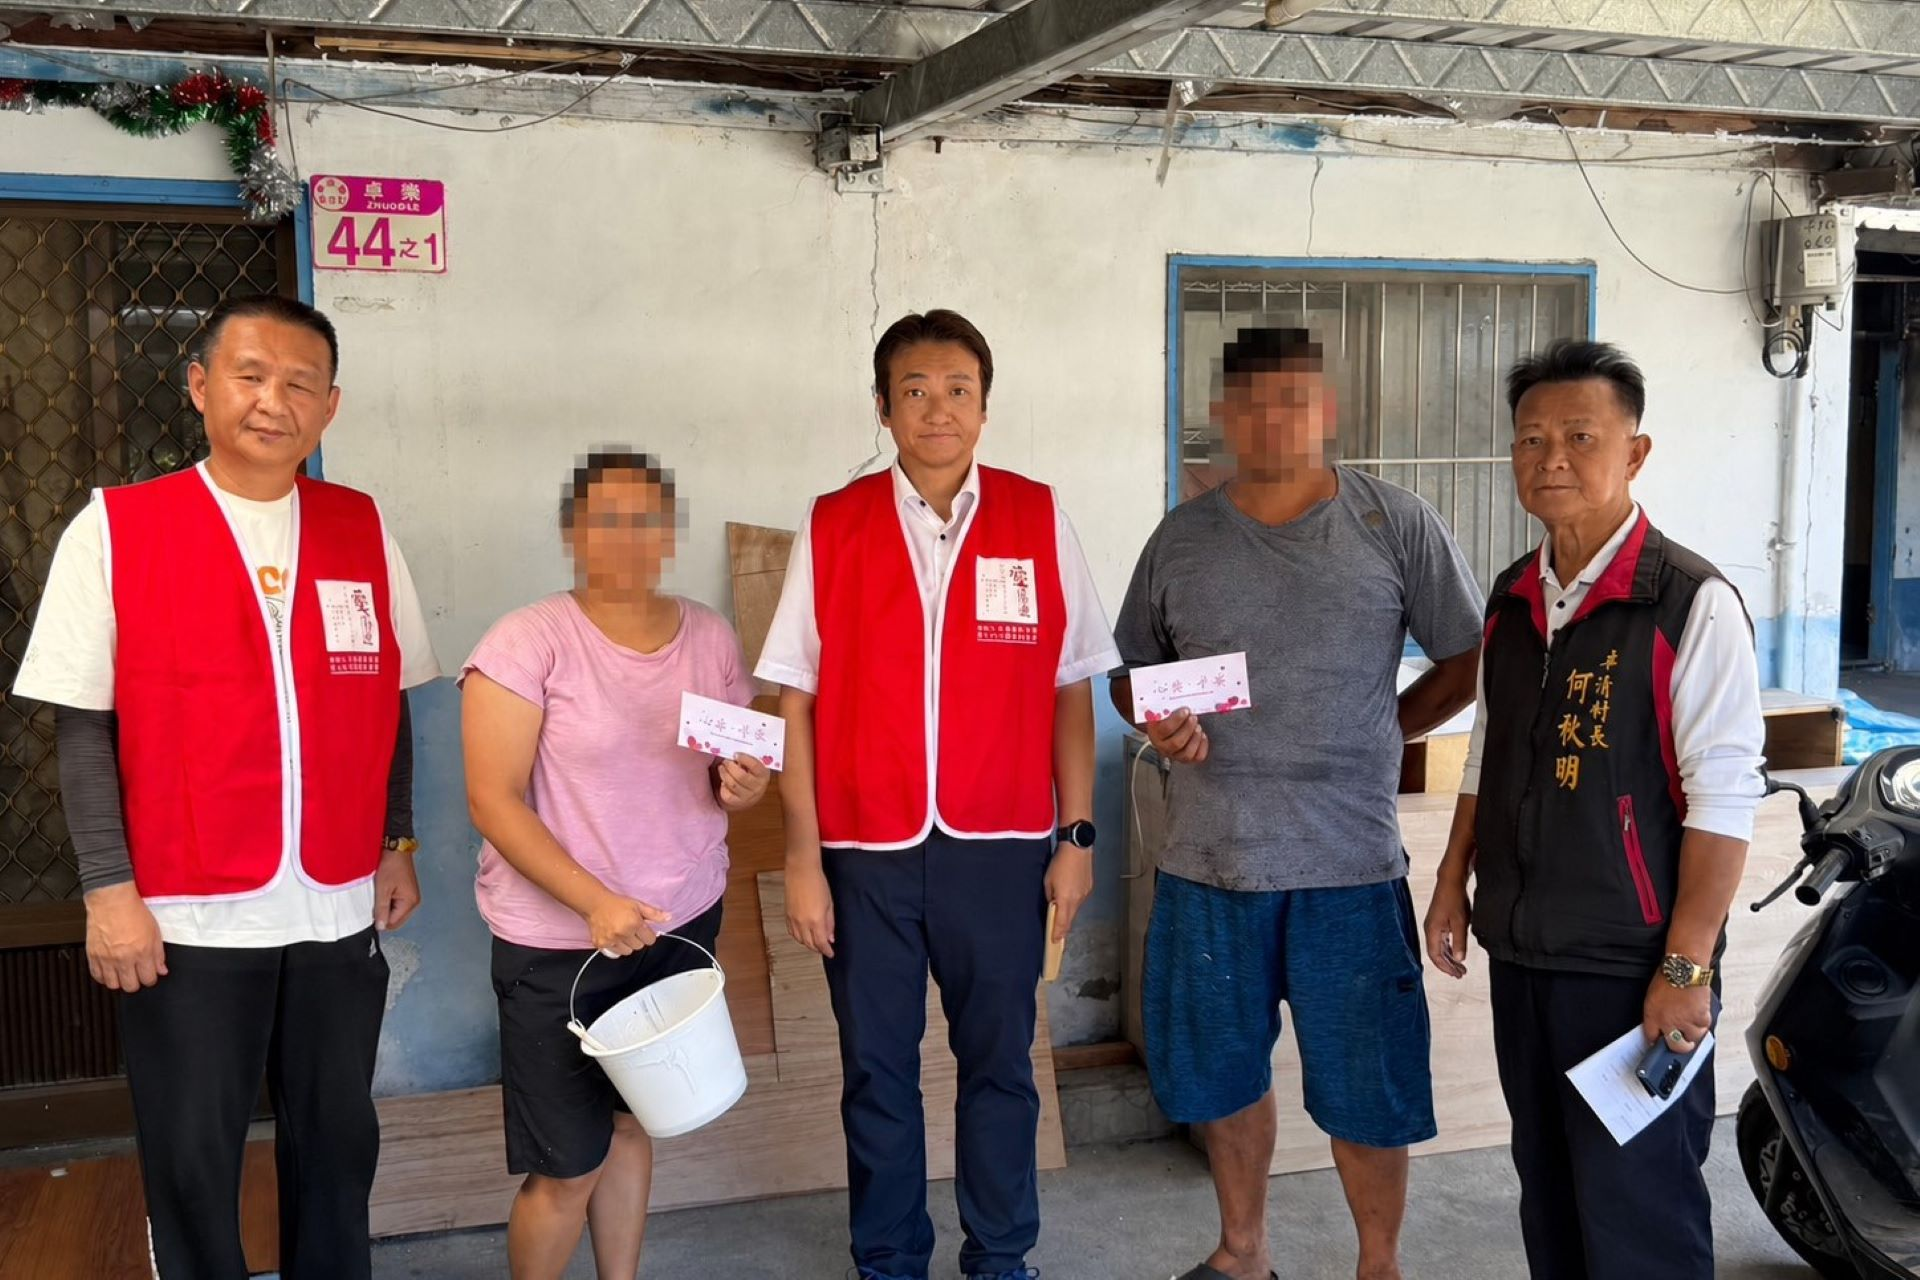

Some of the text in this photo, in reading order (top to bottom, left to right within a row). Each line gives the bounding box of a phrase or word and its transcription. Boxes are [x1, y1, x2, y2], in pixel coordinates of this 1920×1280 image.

[326, 215, 438, 267] 44之1
[1555, 667, 1594, 791] 何秋明
